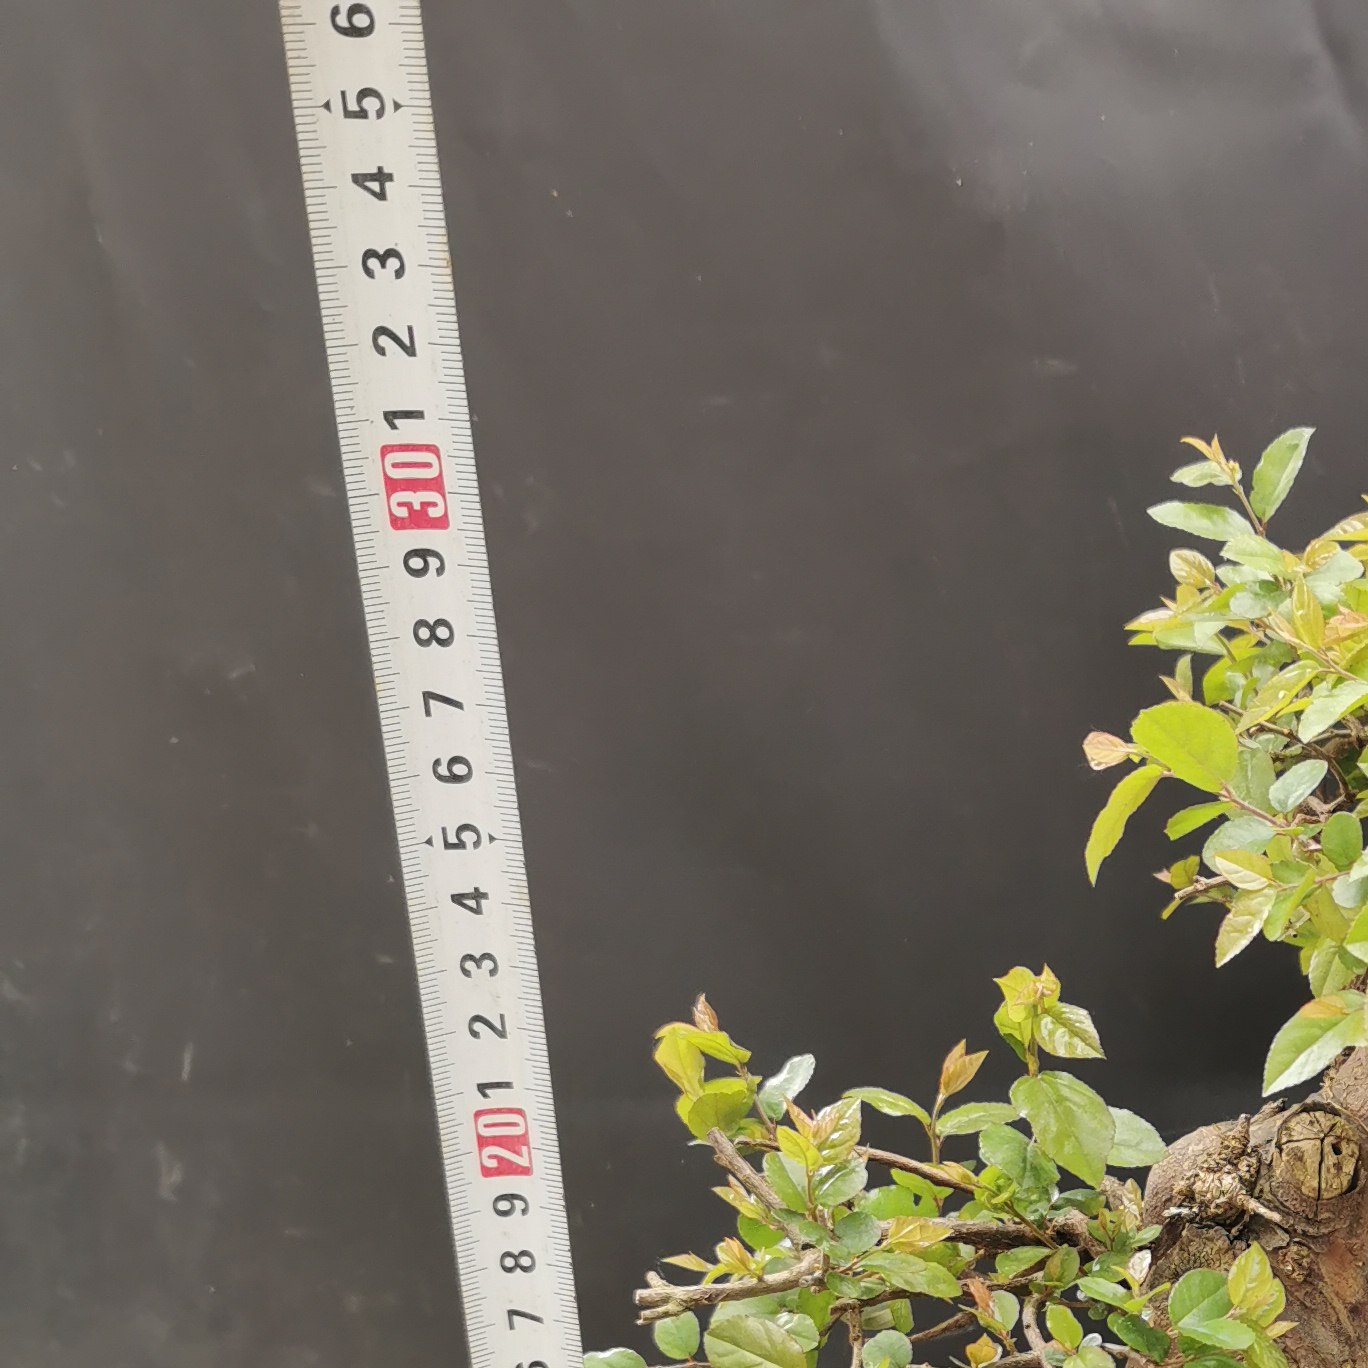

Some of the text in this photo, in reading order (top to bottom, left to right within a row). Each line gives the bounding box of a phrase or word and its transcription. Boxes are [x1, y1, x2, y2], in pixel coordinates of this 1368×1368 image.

[330, 2, 376, 38] 6
[340, 87, 386, 120] 5
[350, 166, 394, 201] 4
[361, 248, 405, 280] 3
[372, 325, 417, 357] 2
[382, 409, 425, 430] 1
[383, 451, 446, 519] 30
[403, 548, 445, 578] 9
[413, 618, 454, 648] 8
[421, 690, 464, 717] 7
[432, 755, 473, 784] 6
[441, 823, 482, 850] 5
[450, 886, 489, 915] 4
[459, 952, 499, 978] 3
[468, 1013, 508, 1040] 2
[476, 1081, 513, 1099] 1
[477, 1112, 531, 1169] 20
[492, 1193, 529, 1217] 9
[500, 1250, 536, 1273] 8
[507, 1308, 544, 1330] 7
